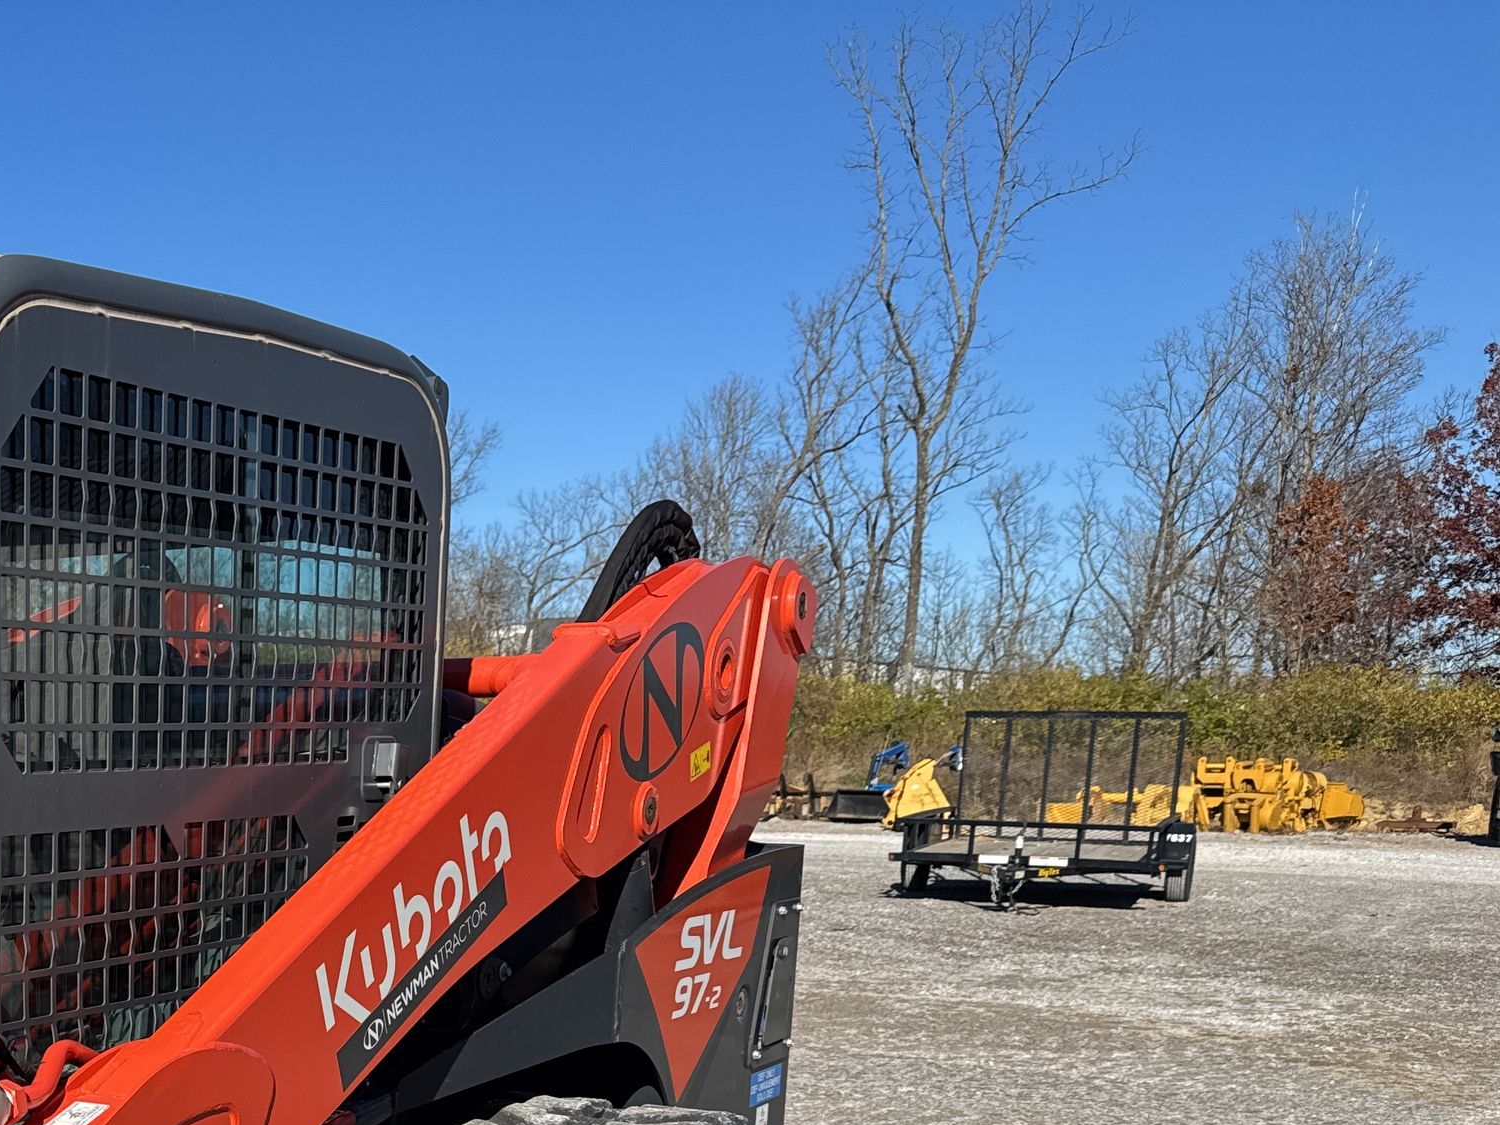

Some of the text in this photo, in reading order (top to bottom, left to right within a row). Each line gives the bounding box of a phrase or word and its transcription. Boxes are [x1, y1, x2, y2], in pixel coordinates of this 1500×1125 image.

[315, 810, 512, 1033] Kubota
[386, 900, 488, 1025] NEWMANTRACTOR
[674, 909, 743, 972] SVL
[671, 972, 722, 1020] 97-2
